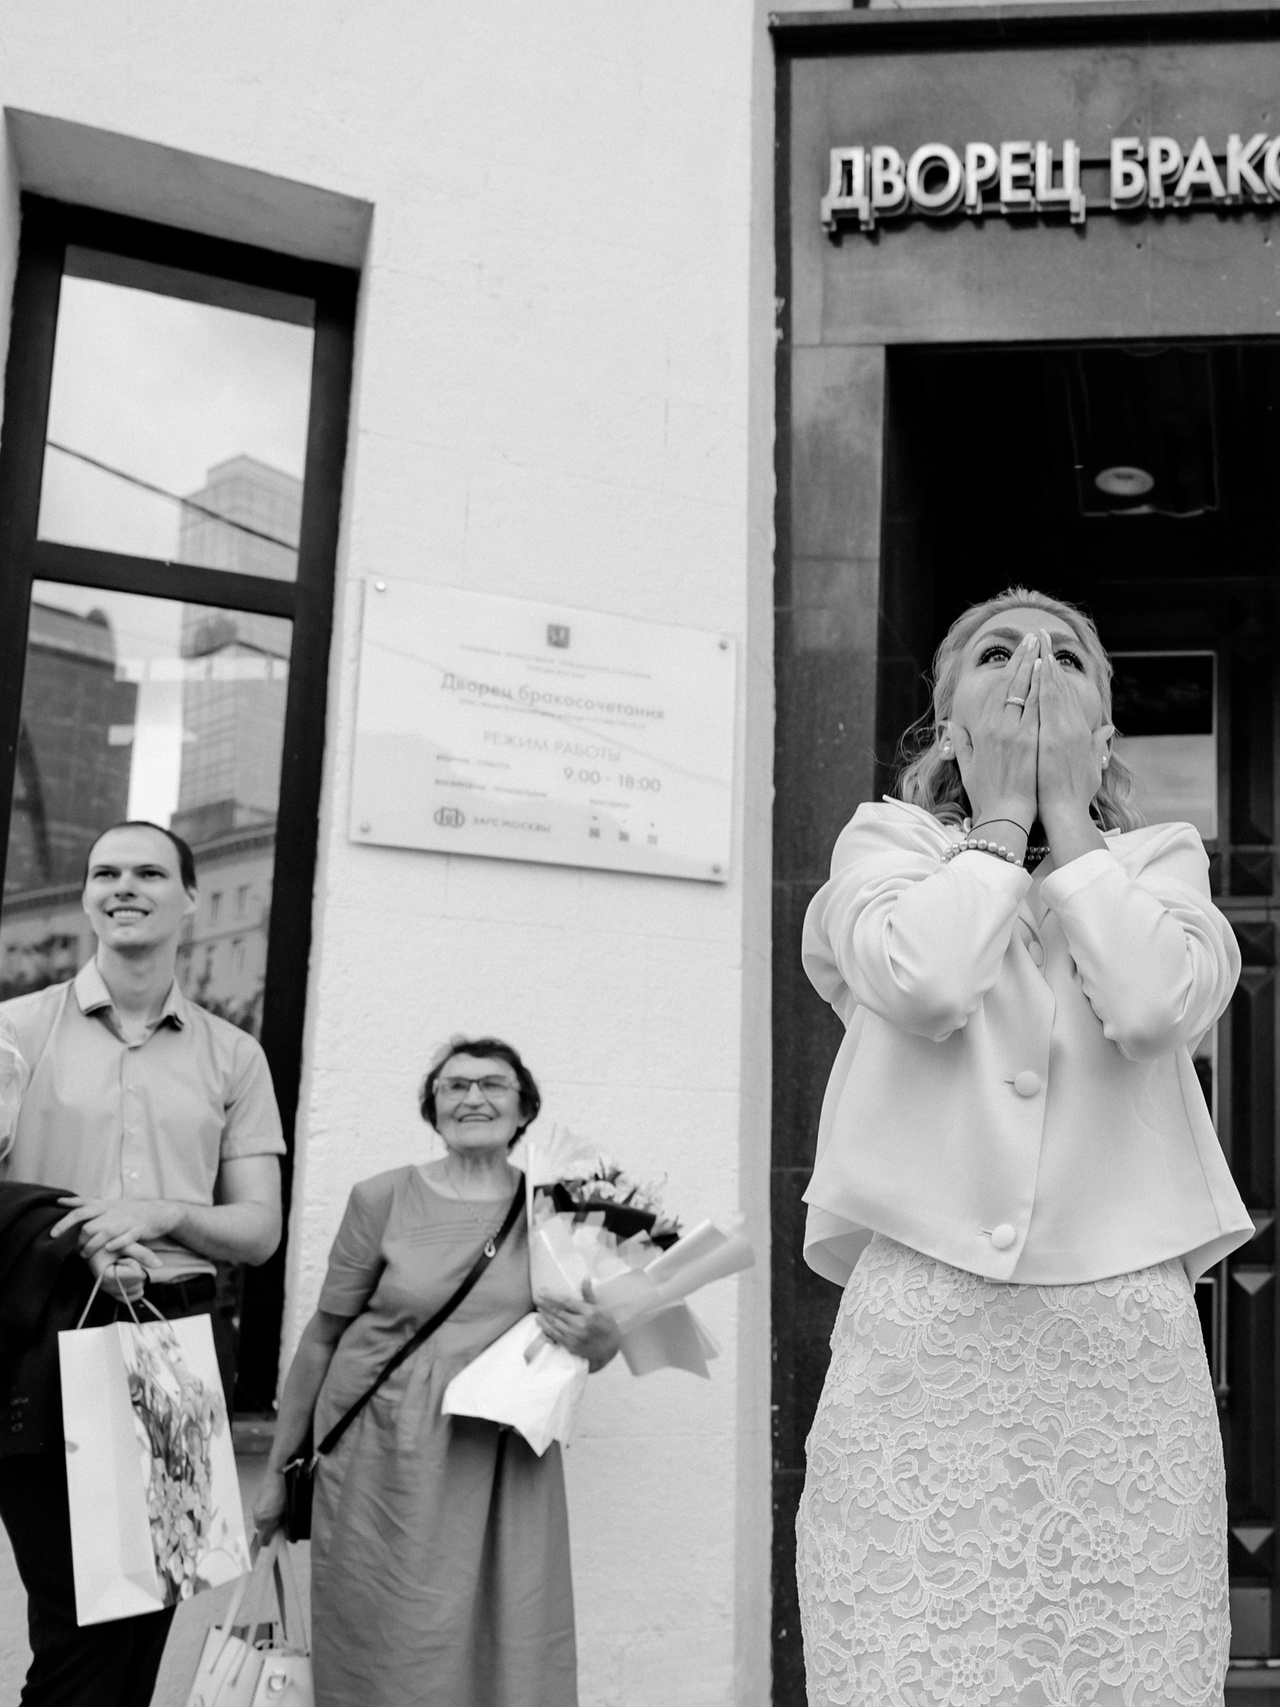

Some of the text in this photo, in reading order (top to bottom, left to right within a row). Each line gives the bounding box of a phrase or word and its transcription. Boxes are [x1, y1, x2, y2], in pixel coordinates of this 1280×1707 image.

[820, 140, 1087, 231] ДВОРЕЦ
[440, 671, 513, 701] Дворец
[518, 683, 665, 720] бракосочетания
[483, 730, 621, 762] РЕЖИМ РАБОТЫ
